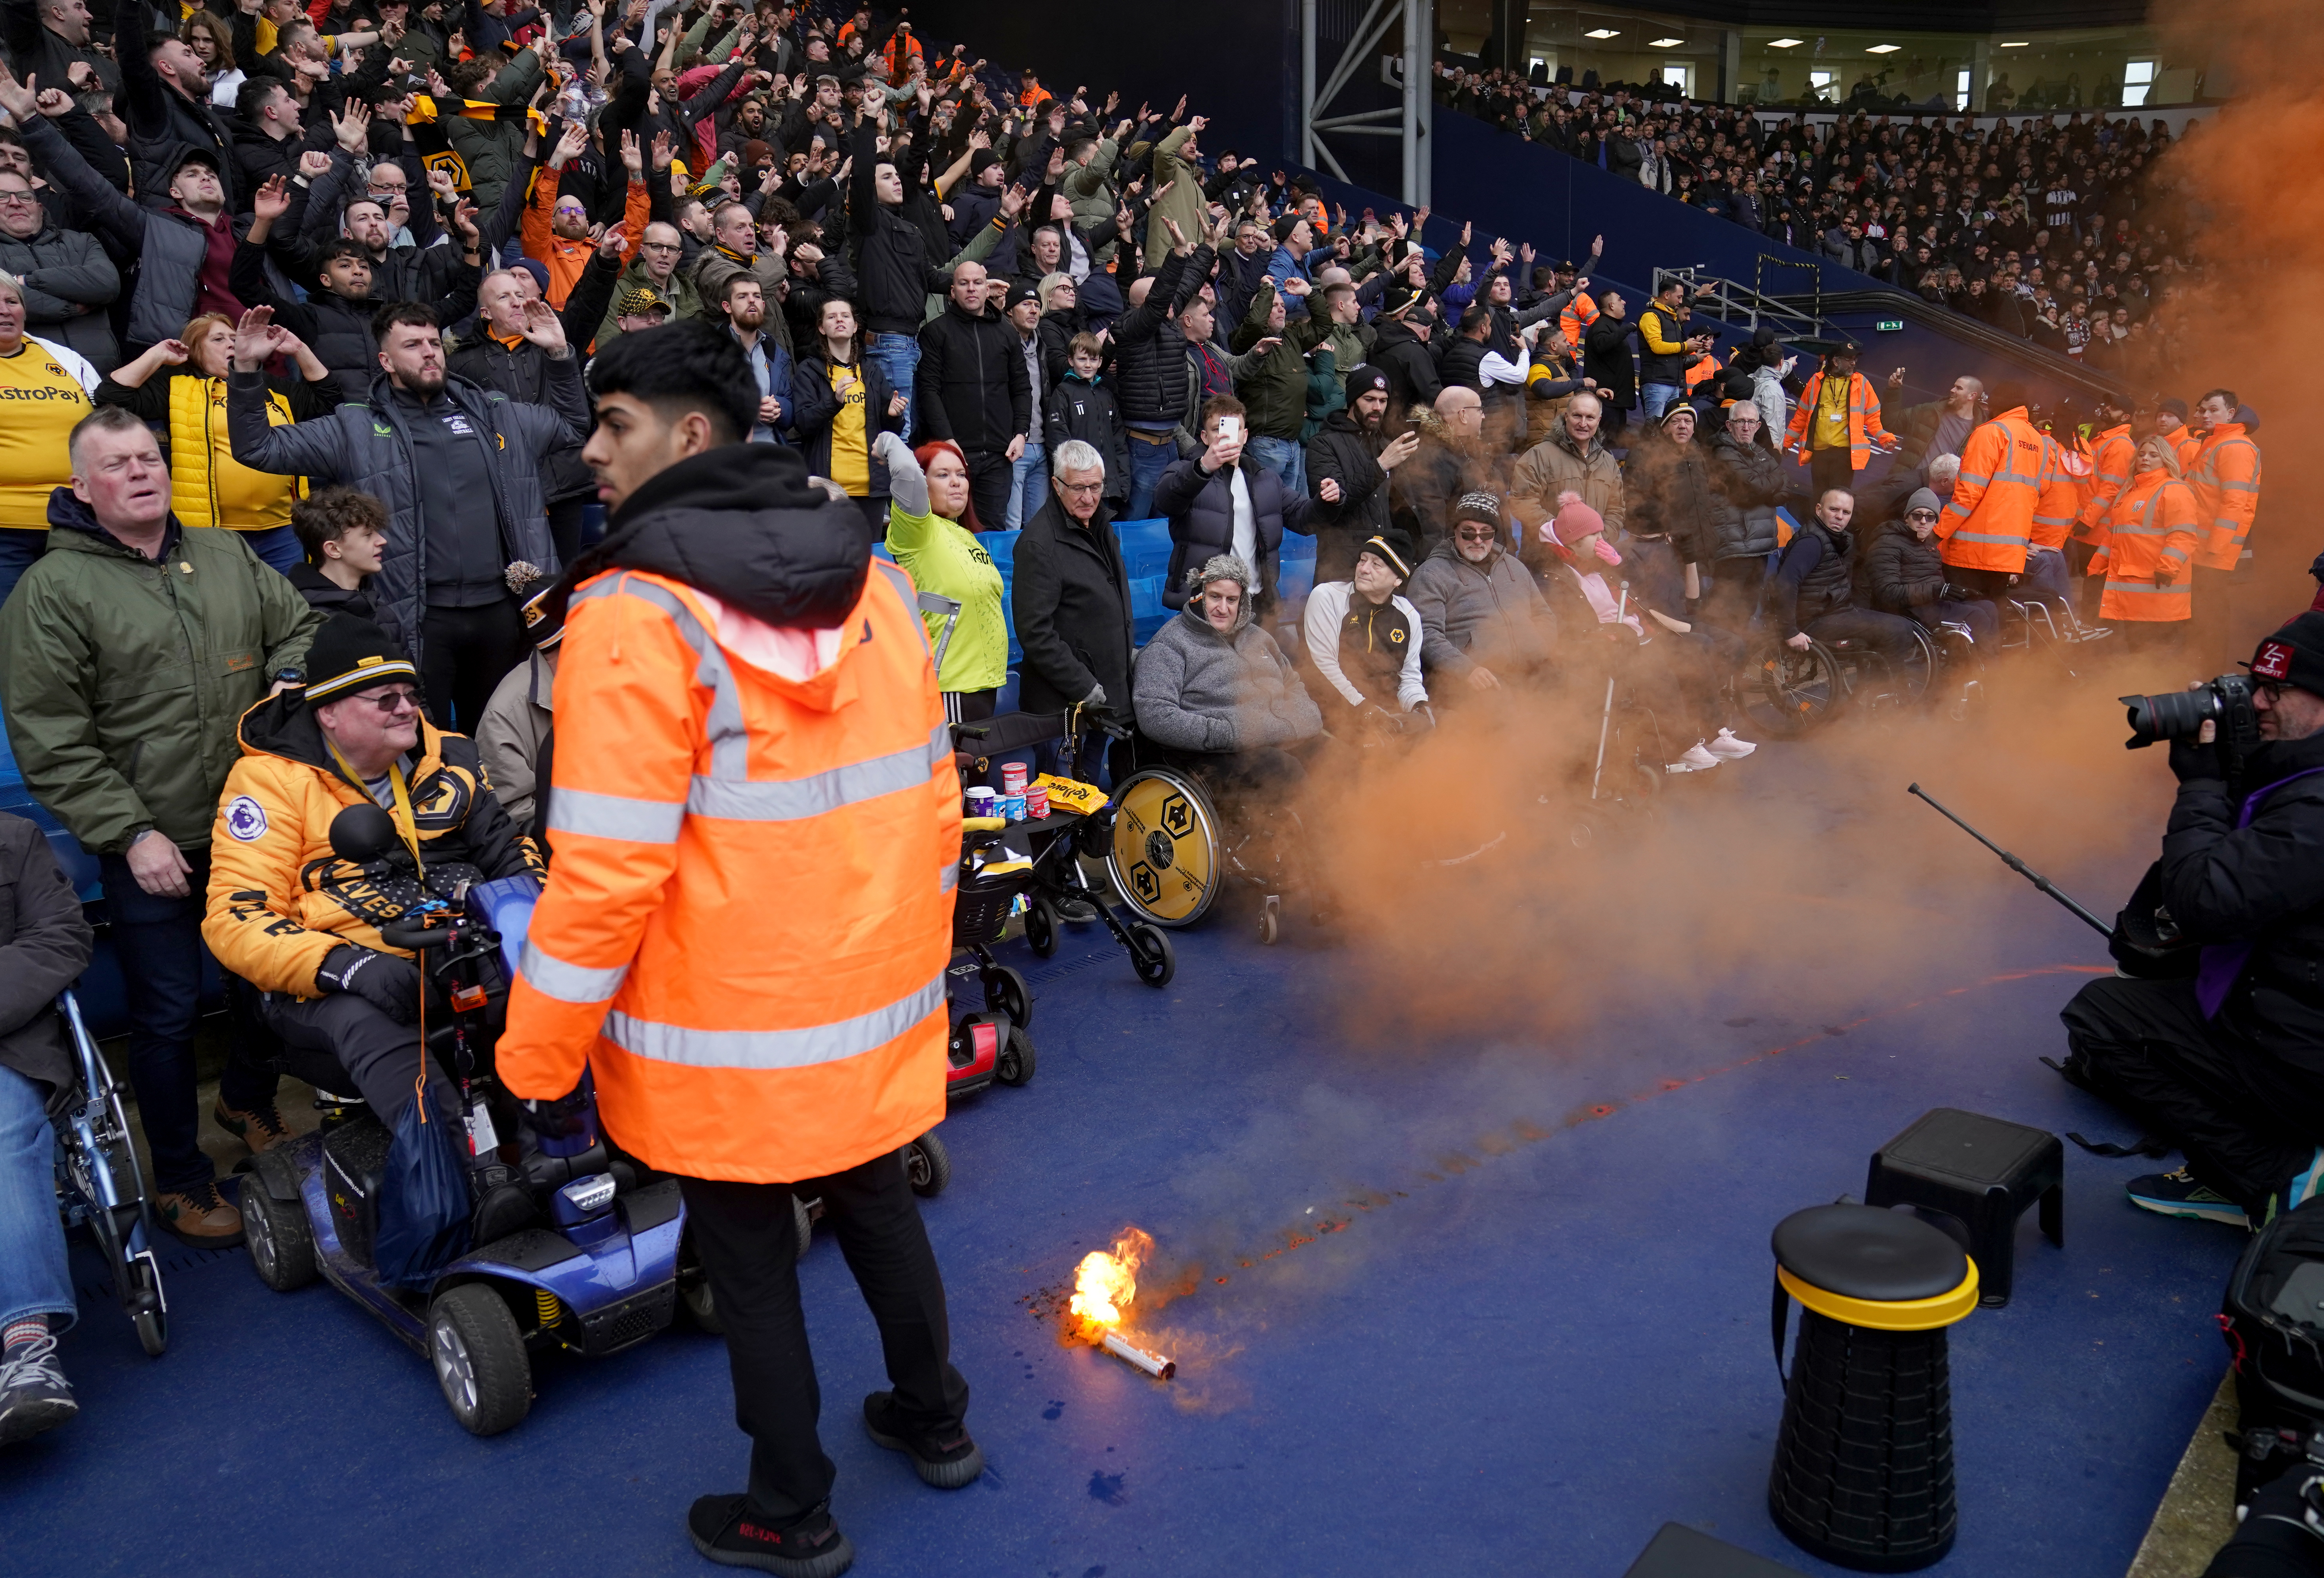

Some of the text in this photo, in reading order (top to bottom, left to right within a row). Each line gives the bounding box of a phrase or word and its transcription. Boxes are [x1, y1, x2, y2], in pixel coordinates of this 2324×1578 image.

[1076, 404, 1085, 415] 11
[2018, 440, 2039, 453] STEWARD
[2254, 664, 2283, 677] ZEROFIT
[1047, 782, 1091, 800] Rollove
[1123, 806, 1144, 835] Wolverhampton
[1131, 811, 1146, 831] Wanderers
